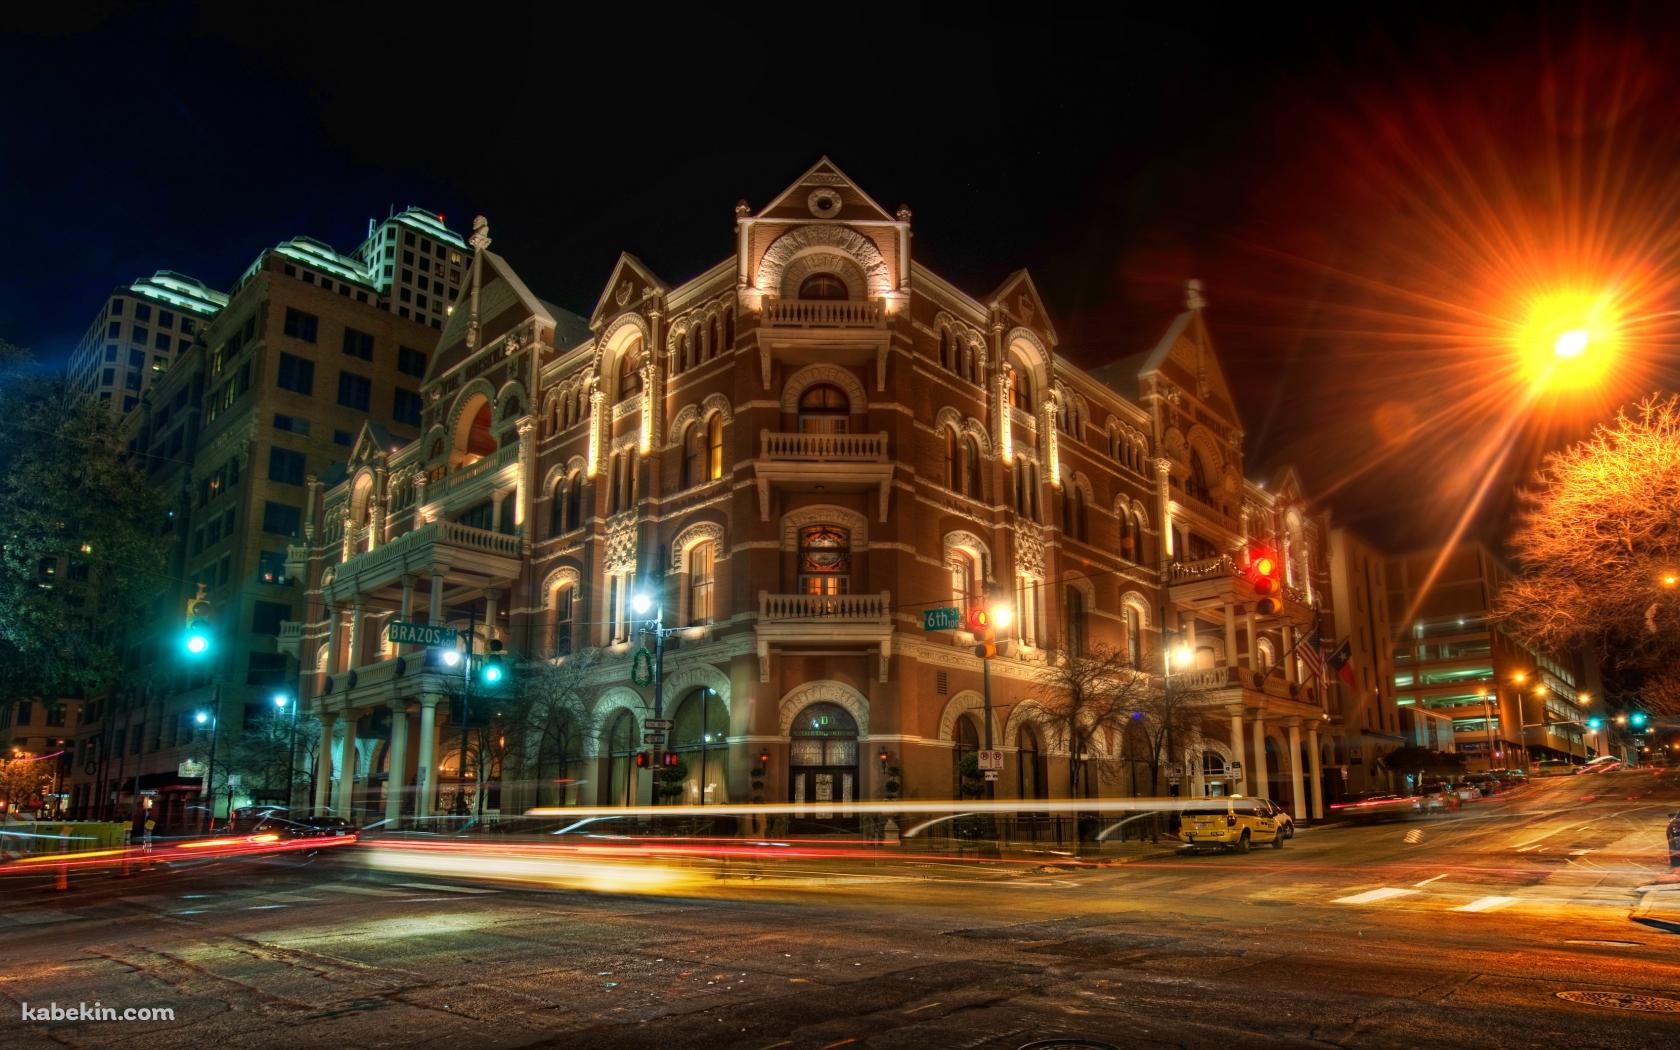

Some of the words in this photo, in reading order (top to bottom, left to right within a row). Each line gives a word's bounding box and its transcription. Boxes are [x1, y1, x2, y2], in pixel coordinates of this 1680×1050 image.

[927, 611, 948, 627] 6th
[391, 624, 441, 644] BRAZOS
[446, 628, 456, 637] ST
